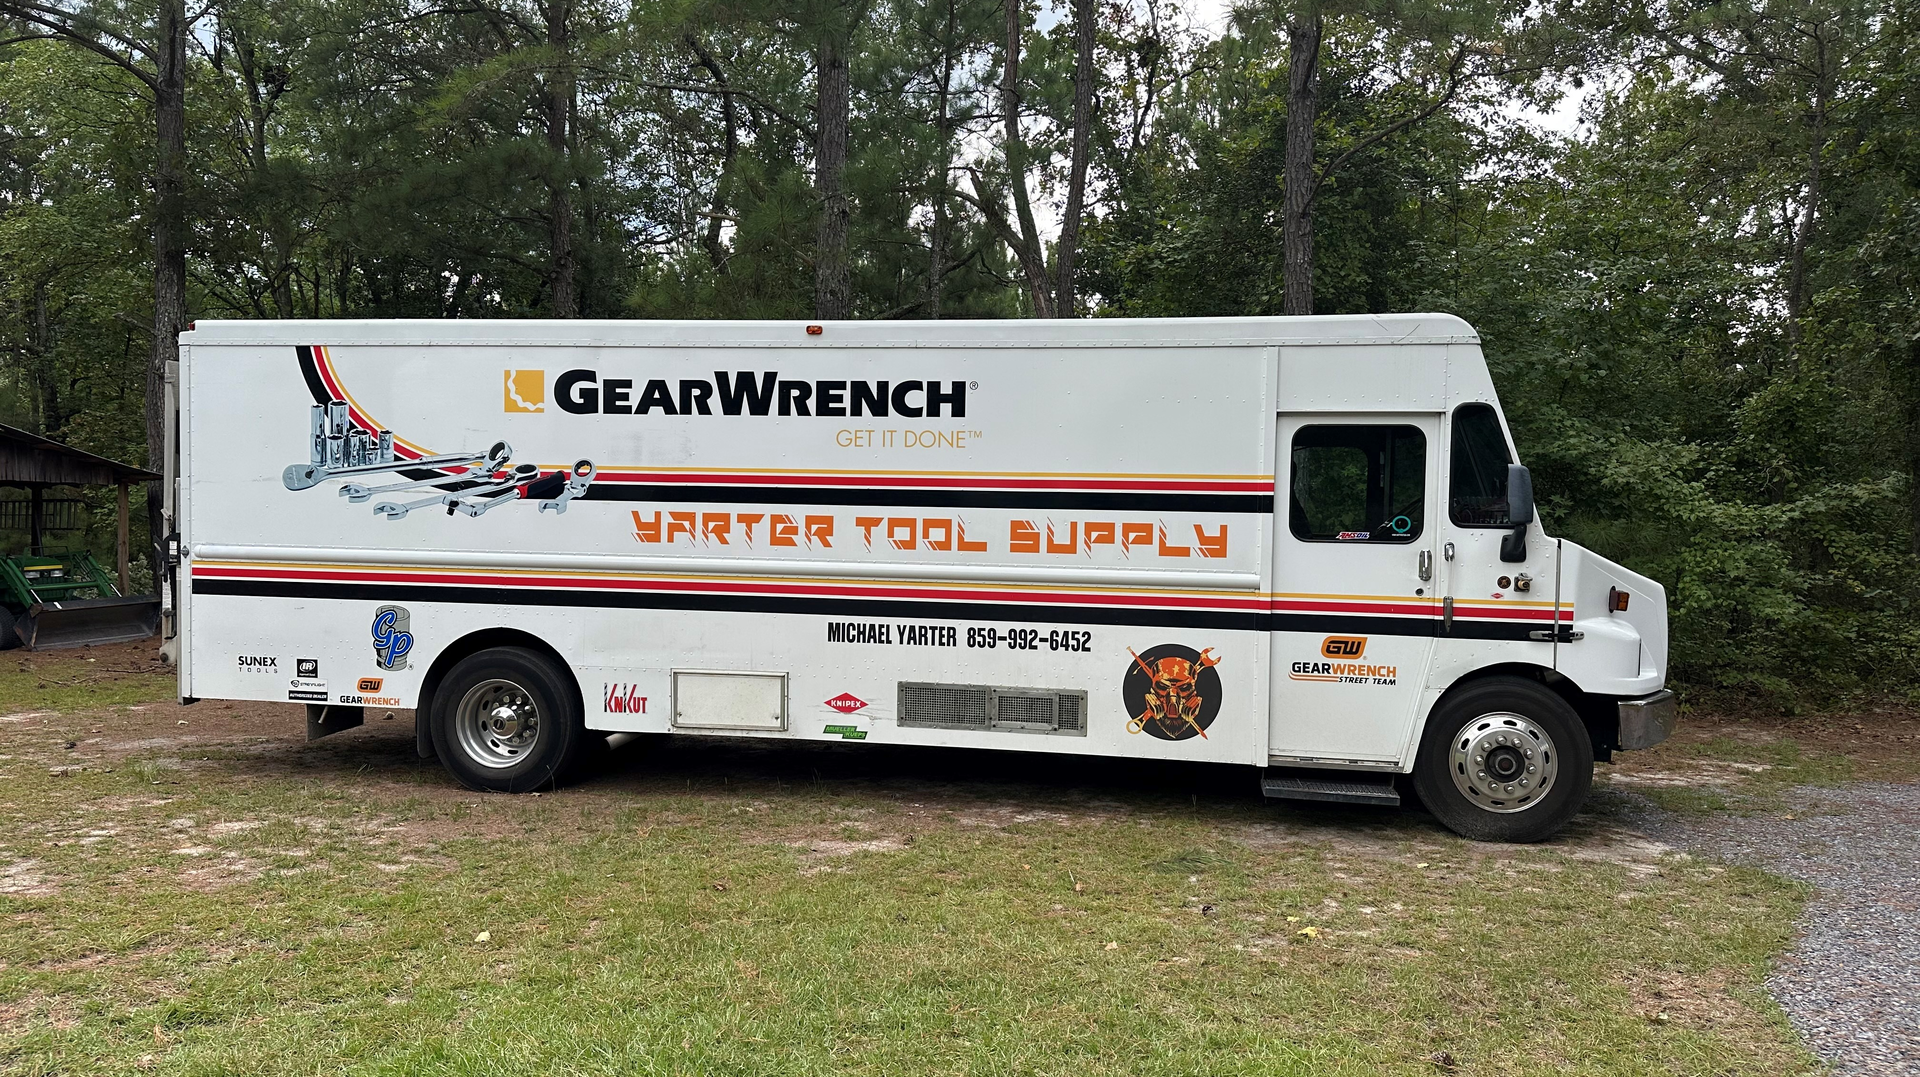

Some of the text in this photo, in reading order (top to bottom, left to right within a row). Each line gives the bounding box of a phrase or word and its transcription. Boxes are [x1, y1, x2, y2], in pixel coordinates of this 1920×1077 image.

[835, 428, 873, 448] GET
[881, 429, 897, 447] IT
[631, 510, 1228, 560] YARTER TOOL SUPPLY
[827, 621, 1092, 652] MICHAEL YARTER 859-992-6452
[1325, 640, 1362, 655] GW
[238, 656, 277, 667] SUNEX
[1291, 661, 1397, 678] GEARWRENCH
[359, 680, 381, 691] GW
[1338, 676, 1397, 686] STREET TEAM
[339, 695, 400, 705] GEARWRENCH
